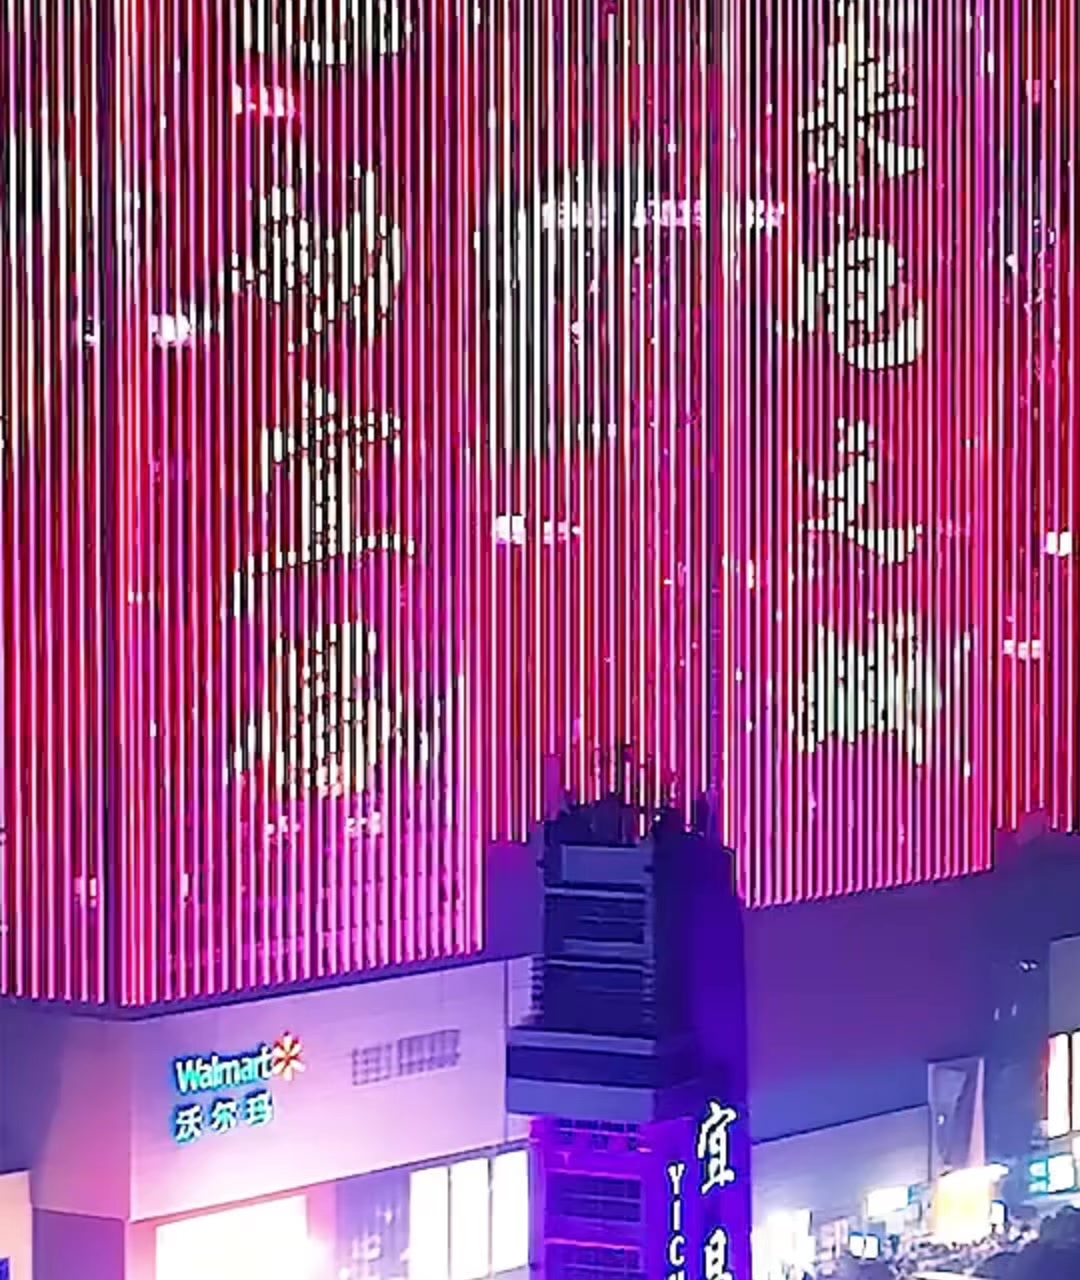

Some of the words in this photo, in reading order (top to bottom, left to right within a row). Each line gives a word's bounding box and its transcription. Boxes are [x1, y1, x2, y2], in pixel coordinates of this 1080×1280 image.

[174, 1044, 273, 1095] Walmart
[174, 1089, 273, 1145] 沃尔玛
